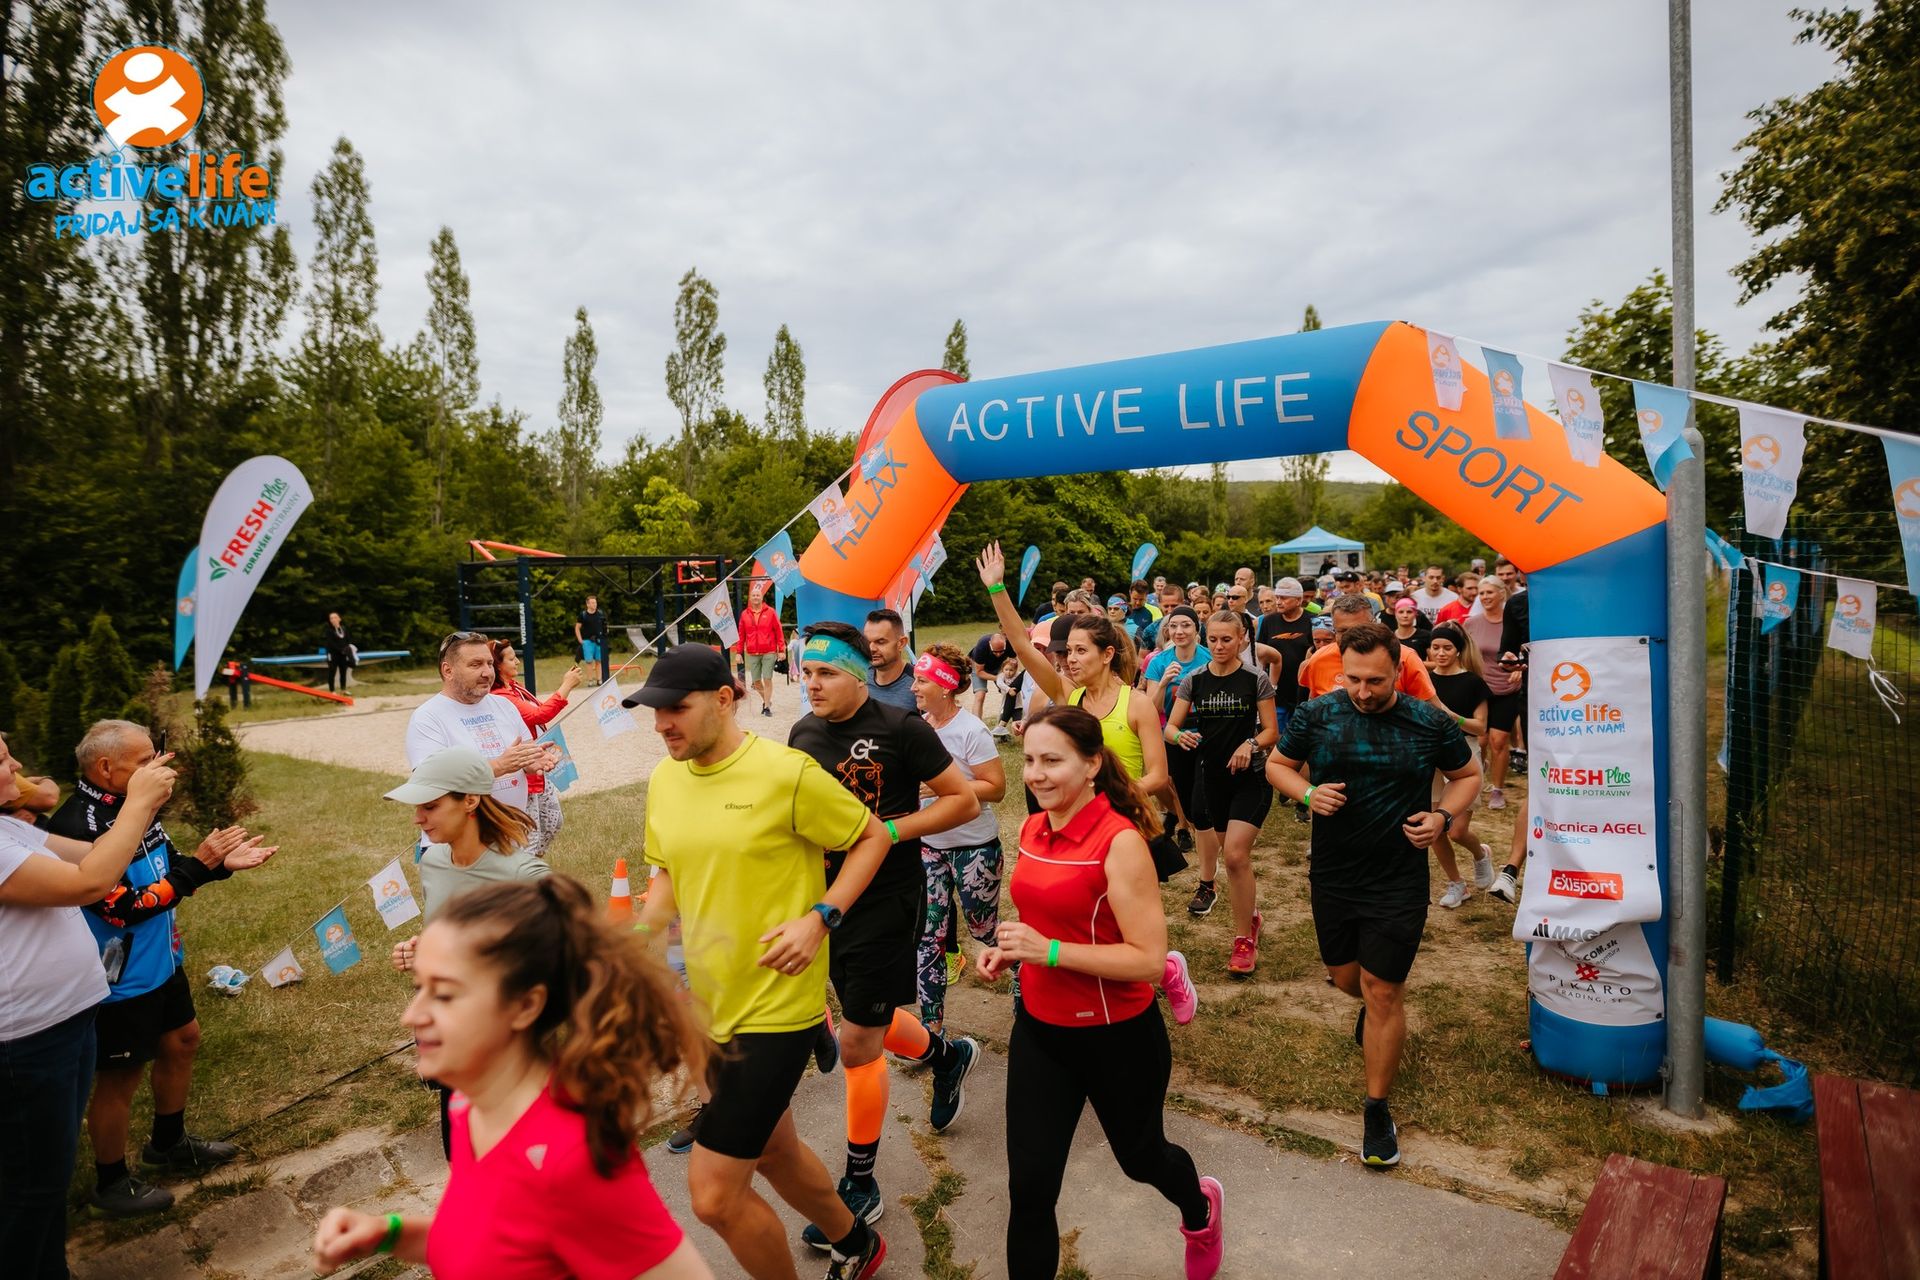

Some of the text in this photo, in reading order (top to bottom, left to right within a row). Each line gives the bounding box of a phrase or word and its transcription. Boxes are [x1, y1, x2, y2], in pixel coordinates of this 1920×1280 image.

[947, 371, 1315, 443] ACTIVE LIFE
[1396, 410, 1584, 525] SPORT
[220, 478, 288, 568] FRESH Plus
[269, 492, 301, 535] POTRAVINY
[1568, 725, 1582, 736] SA
[1586, 724, 1594, 734] K
[1548, 766, 1631, 786] FRESH Plus
[78, 780, 103, 800] TEAM
[1582, 789, 1631, 797] POTRAVINY
[1602, 822, 1647, 835] AGEL
[1549, 974, 1632, 996] PIKARO
